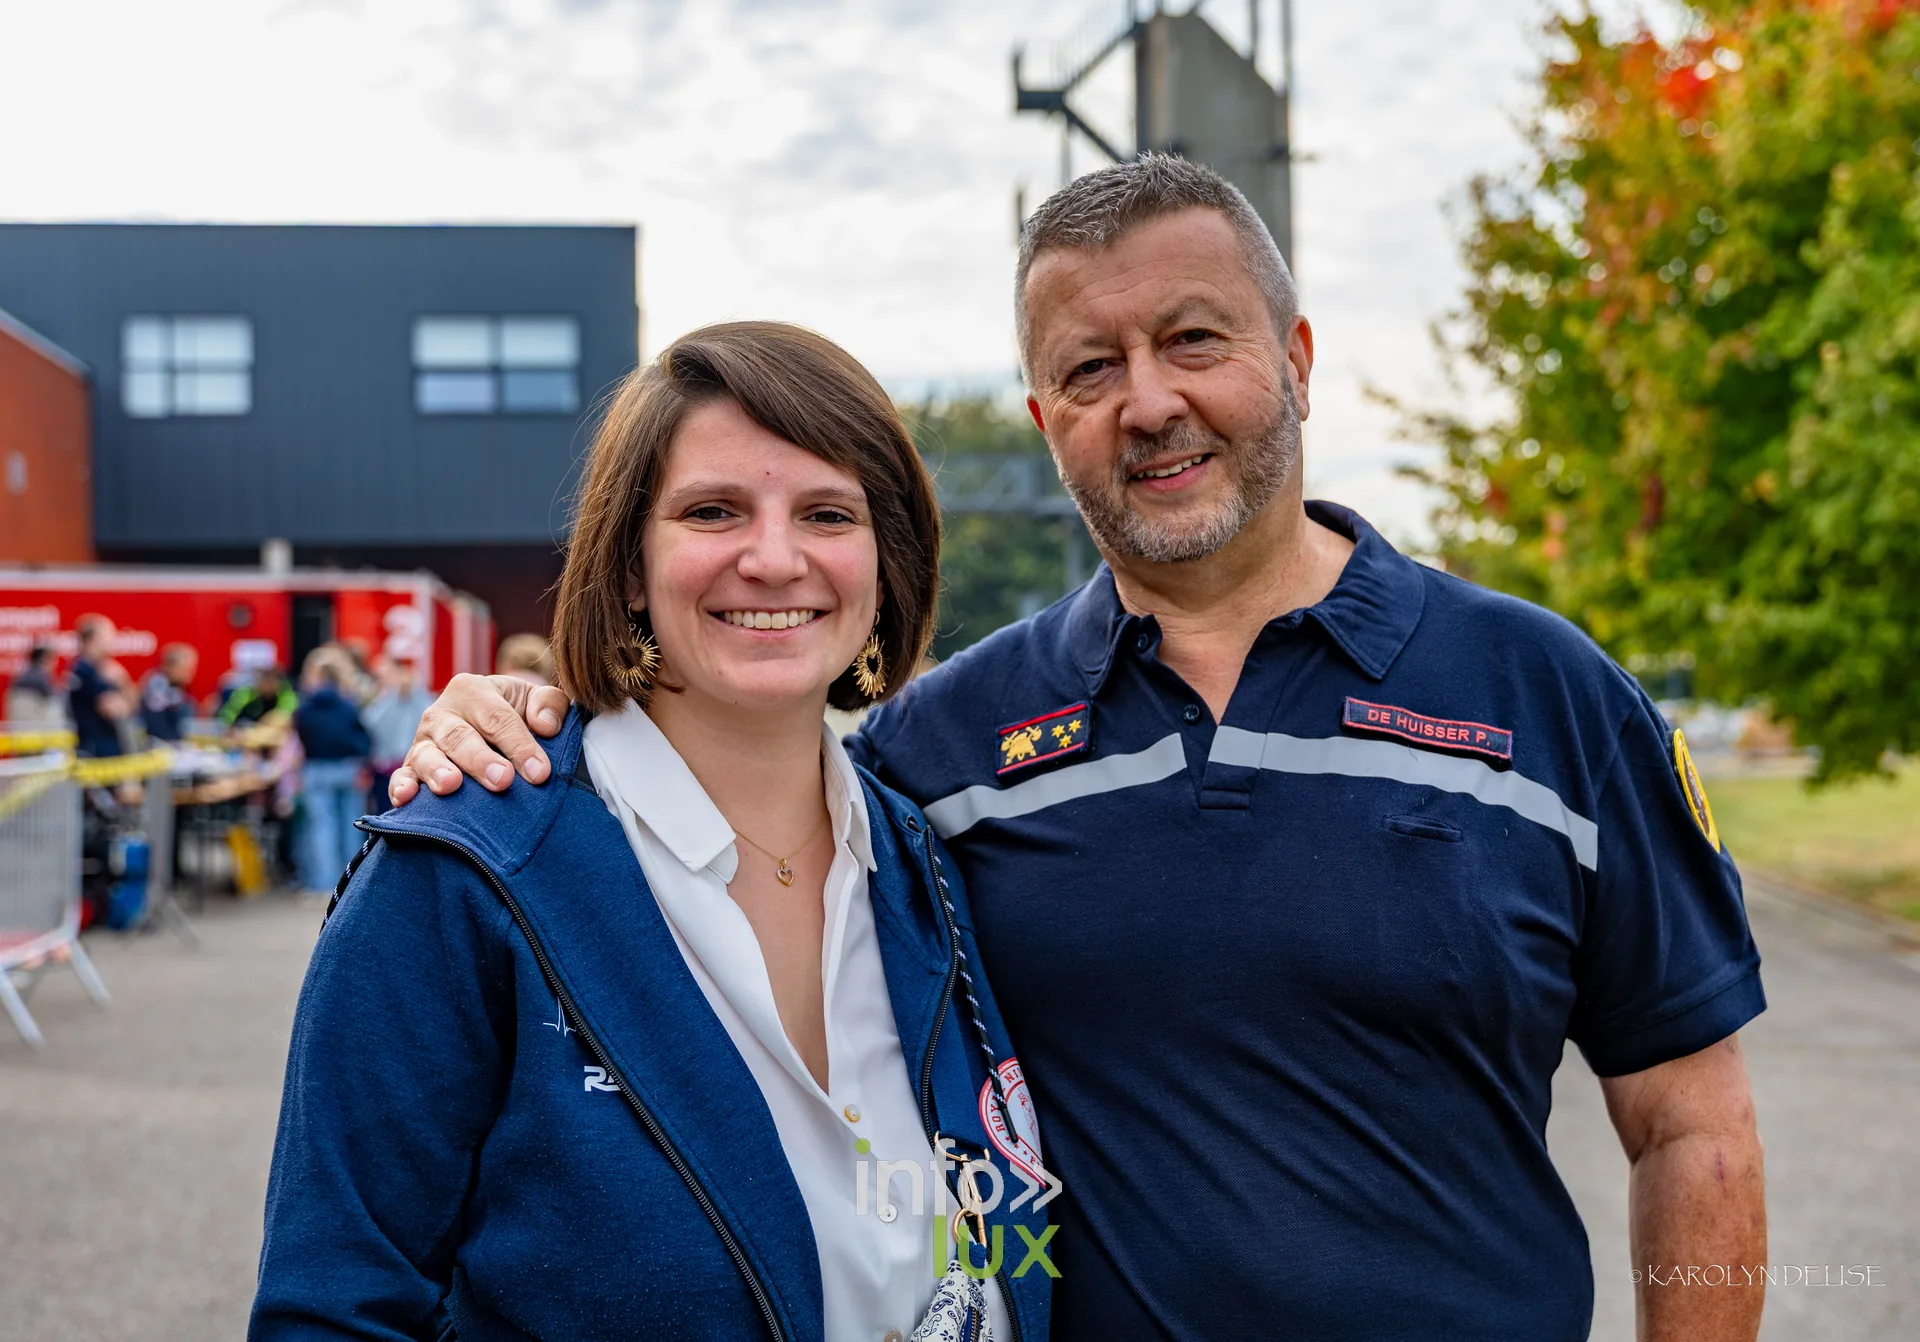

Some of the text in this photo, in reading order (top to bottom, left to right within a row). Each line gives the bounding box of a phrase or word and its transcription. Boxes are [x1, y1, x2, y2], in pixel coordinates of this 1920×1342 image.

[1367, 709, 1491, 746] DE HUISSER P.
